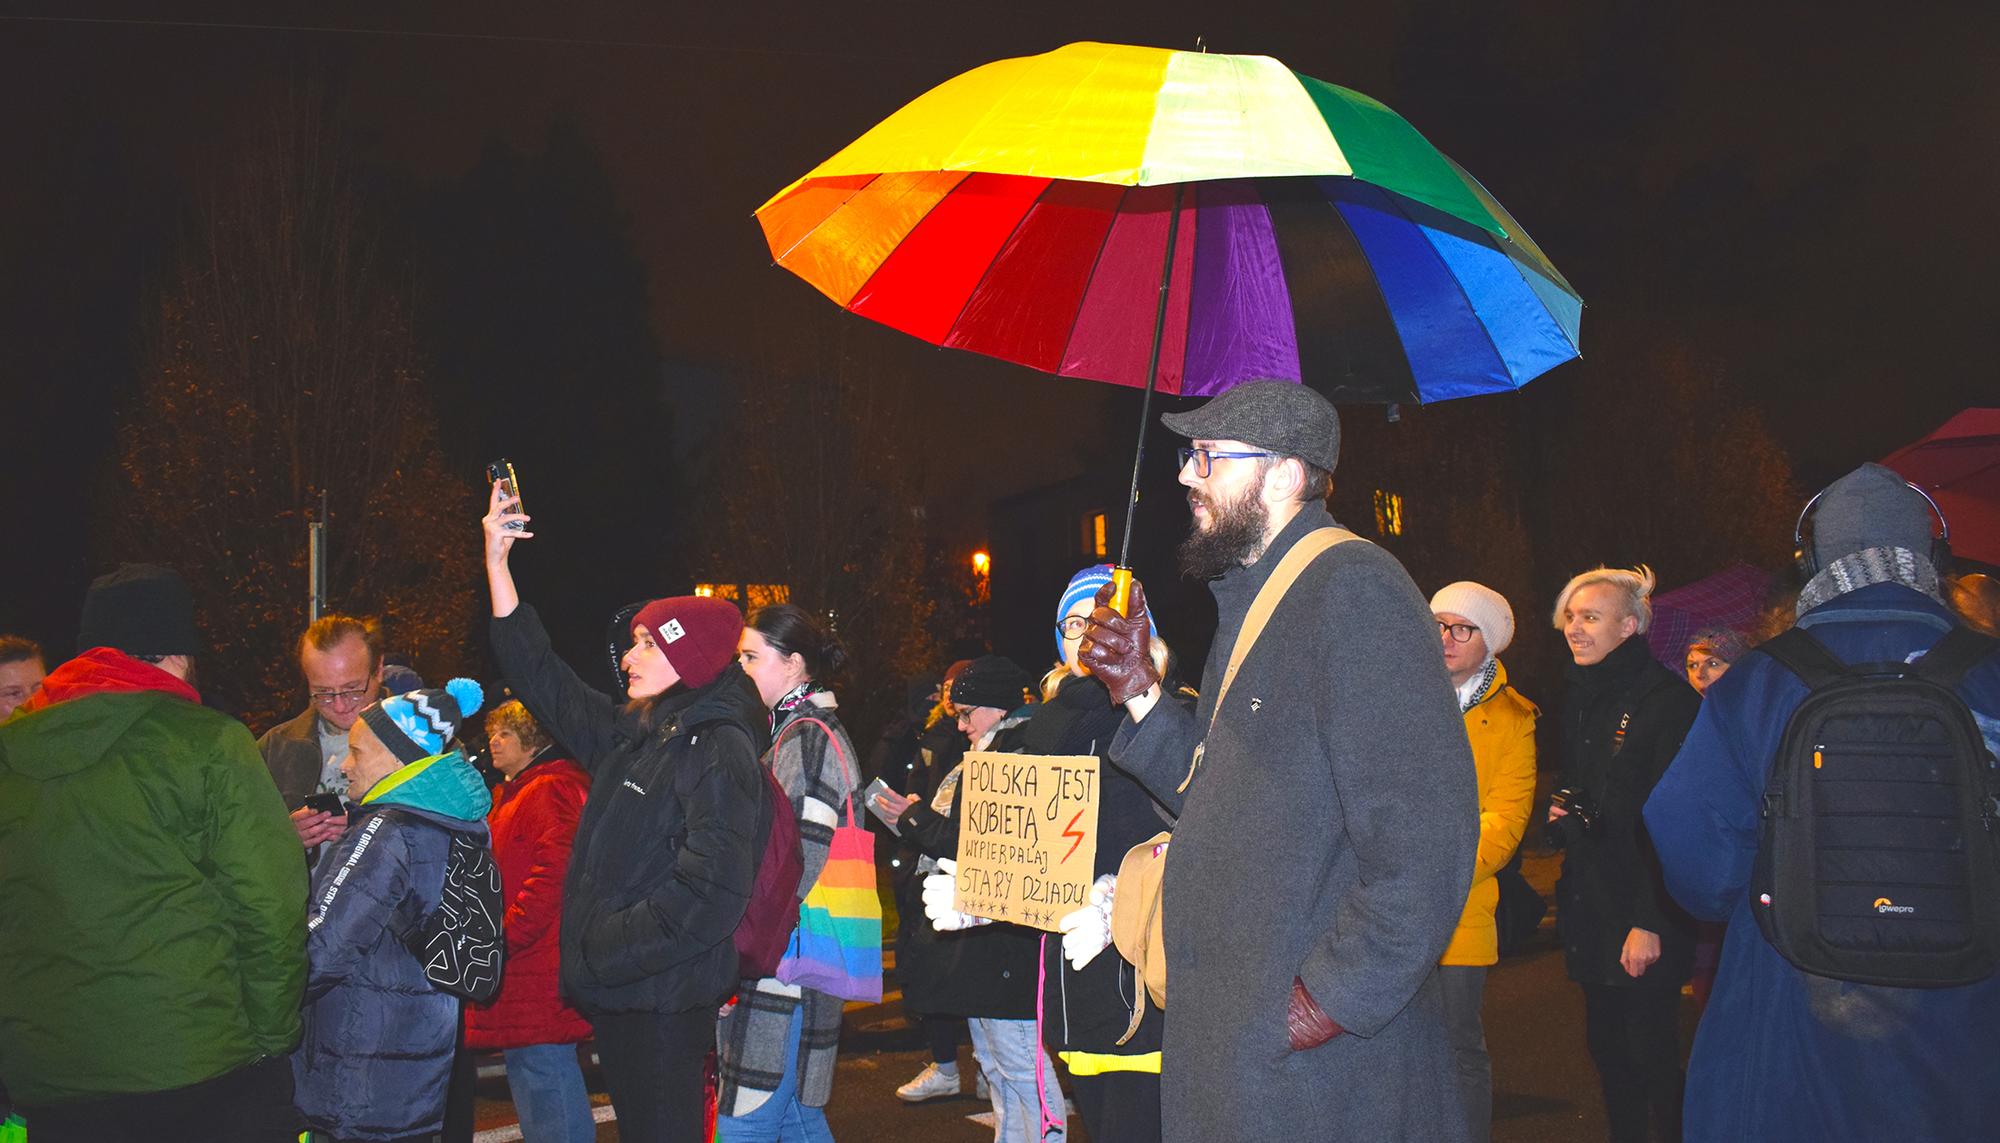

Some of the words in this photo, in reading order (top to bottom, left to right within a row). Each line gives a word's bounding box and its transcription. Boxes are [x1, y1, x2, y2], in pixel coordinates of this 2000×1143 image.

[970, 760, 1038, 797] POLSKA
[1046, 766, 1096, 821] JEST
[366, 816, 384, 835] STAY
[968, 800, 1039, 848] KOBIETĄ
[345, 832, 372, 867] ORIGINAL
[965, 839, 1048, 875] WYPIERDALAJ
[323, 885, 338, 906] STAY
[959, 867, 1014, 900] STARY
[1022, 875, 1086, 906] DZIADU
[308, 904, 328, 932] ORIGIN
